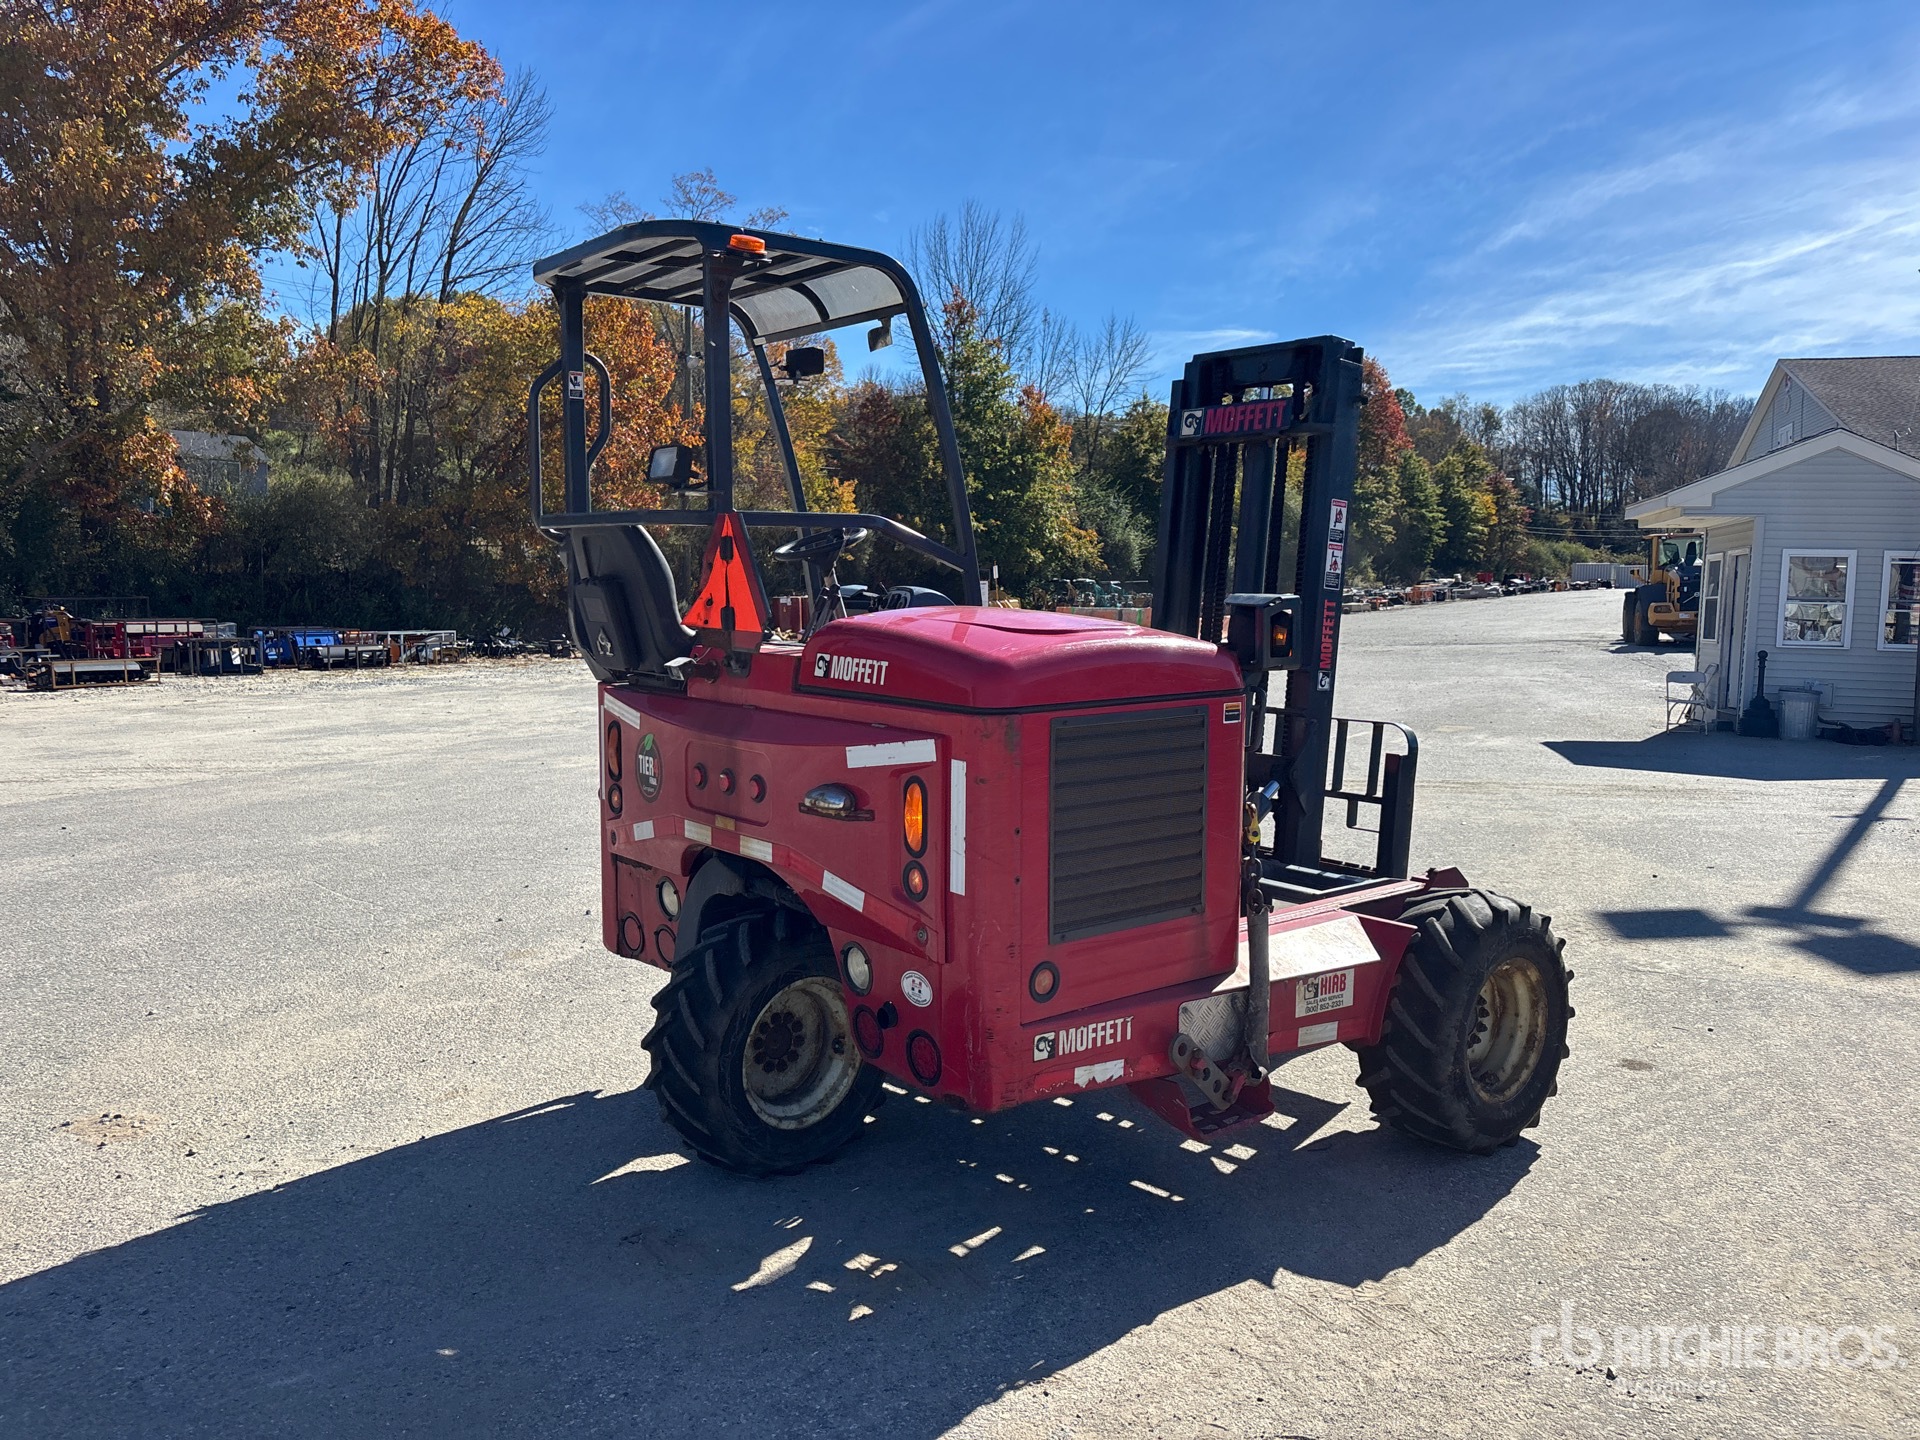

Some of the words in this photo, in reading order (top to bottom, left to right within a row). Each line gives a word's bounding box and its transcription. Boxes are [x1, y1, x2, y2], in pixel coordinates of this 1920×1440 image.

[1204, 400, 1286, 434] MOFFETT
[1319, 599, 1336, 669] MOFFETT
[830, 655, 889, 685] MOFFETT
[1320, 973, 1346, 996] HIAB
[1328, 993, 1344, 1001] SERVICE
[1058, 1016, 1134, 1056] MOFFETT
